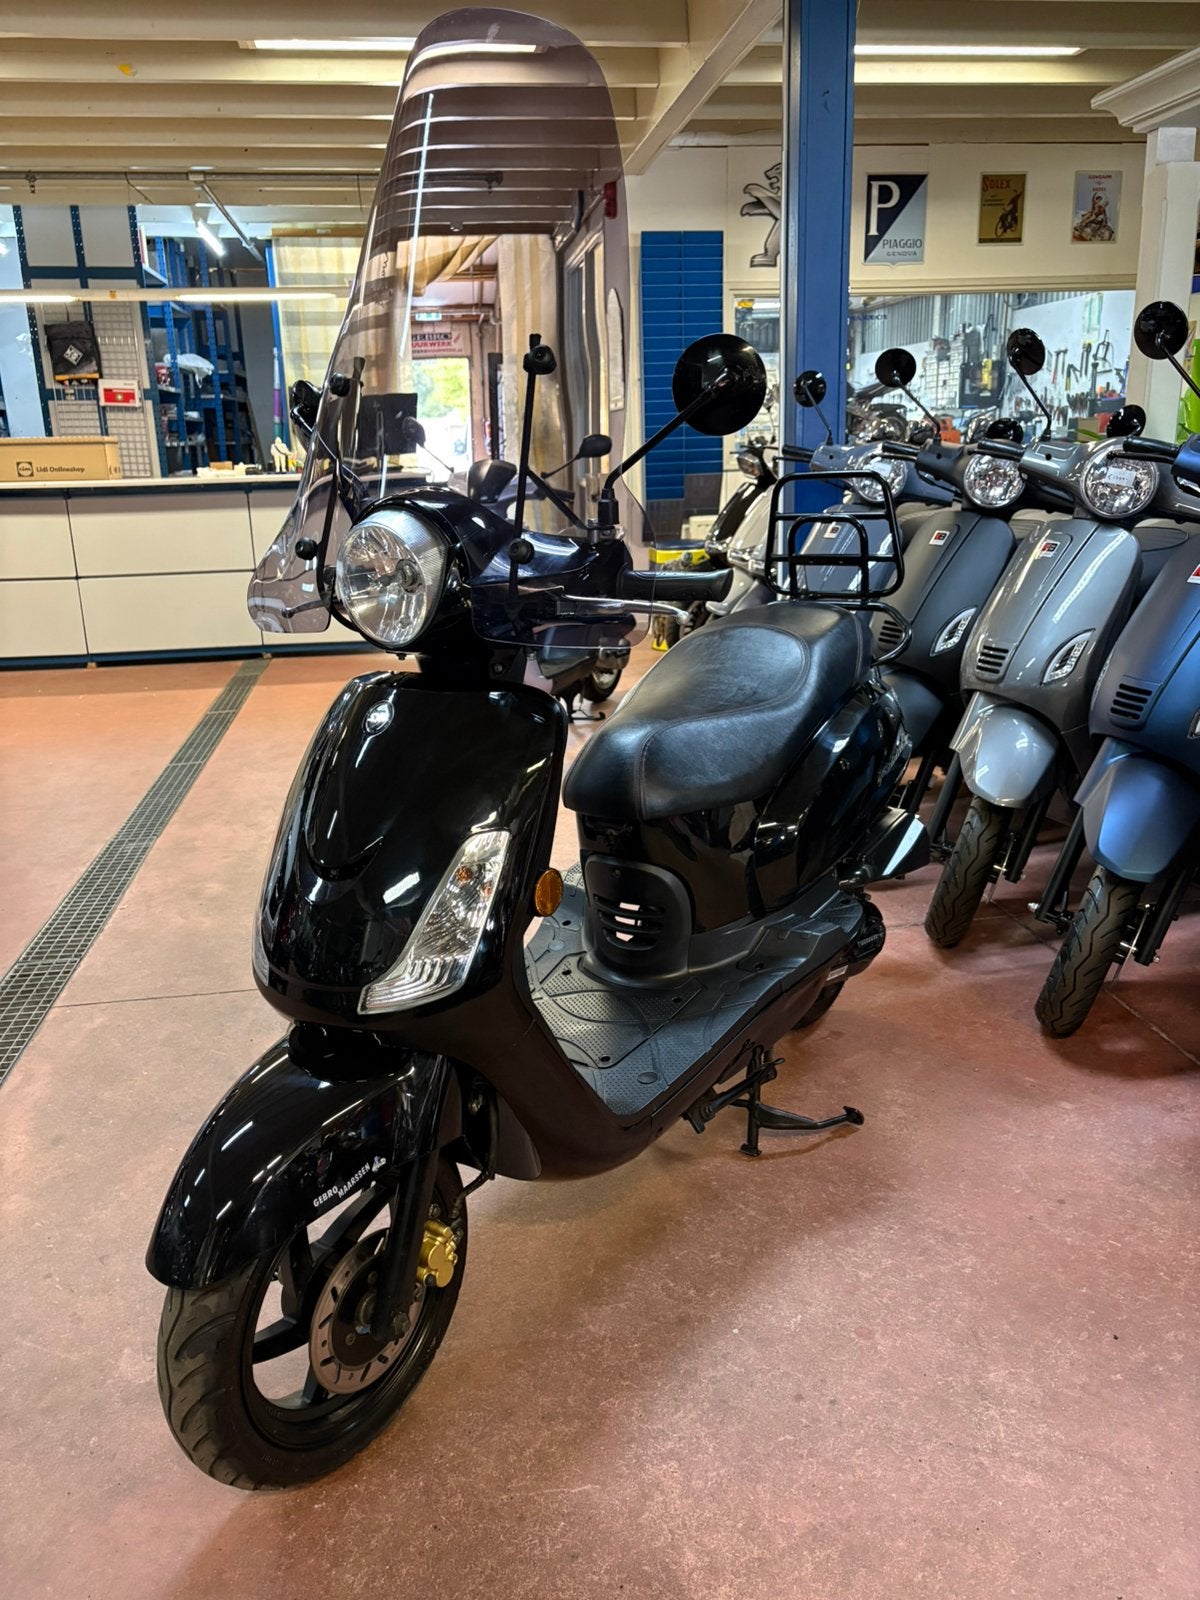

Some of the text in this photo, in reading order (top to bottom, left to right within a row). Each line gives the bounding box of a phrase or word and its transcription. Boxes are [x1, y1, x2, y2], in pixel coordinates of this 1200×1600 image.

[982, 175, 1011, 192] SOLEX
[868, 180, 901, 236] P
[882, 238, 923, 249] PIAGGIO
[337, 1162, 371, 1199] MAARSSEN
[313, 1185, 339, 1208] GEBRO
